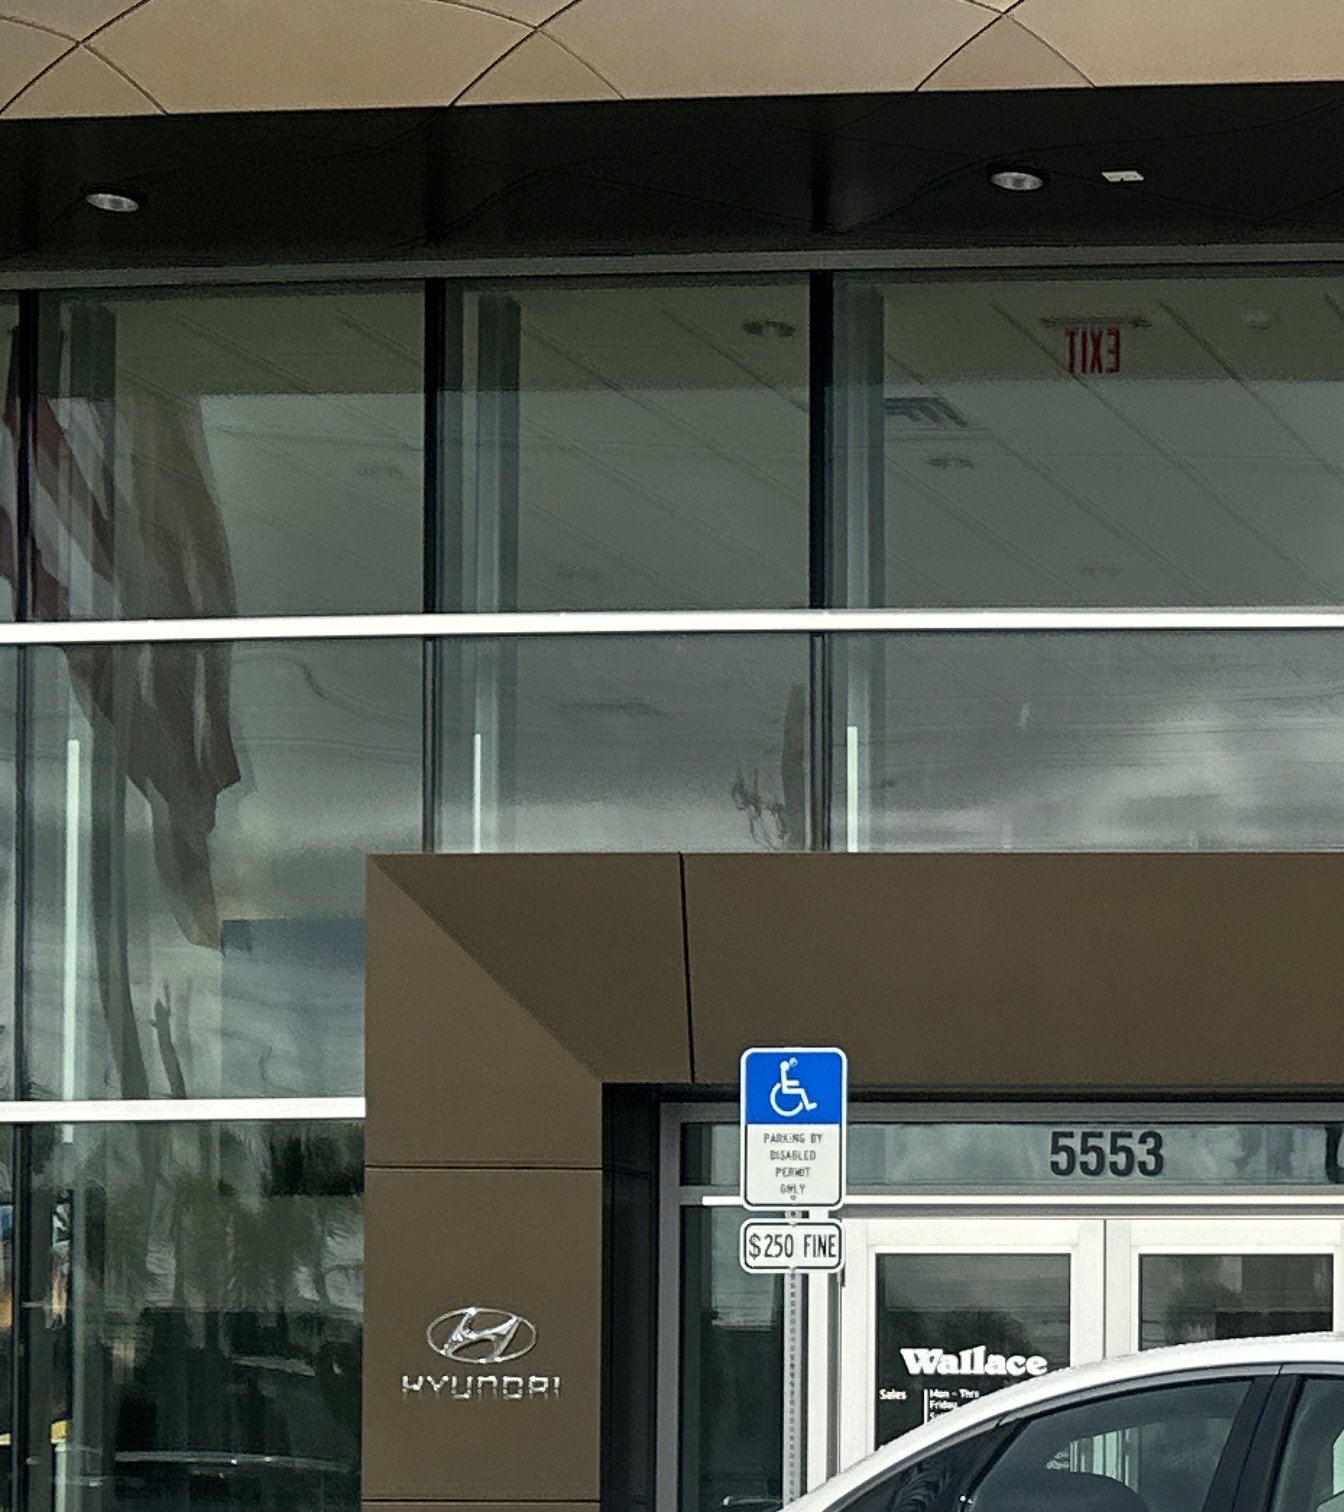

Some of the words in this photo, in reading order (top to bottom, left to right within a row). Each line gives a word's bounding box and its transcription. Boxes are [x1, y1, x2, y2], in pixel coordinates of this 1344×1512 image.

[763, 1132, 806, 1144] PARKING
[810, 1133, 823, 1144] BY
[770, 1149, 817, 1161] DISABLED
[1050, 1130, 1164, 1177] 5553
[775, 1167, 811, 1178] PERMIT
[749, 1232, 795, 1260] $250
[803, 1233, 837, 1258] FINE
[900, 1344, 1048, 1377] Wallace
[402, 1375, 561, 1400] HYUNDAI
[879, 1388, 907, 1400] Sales
